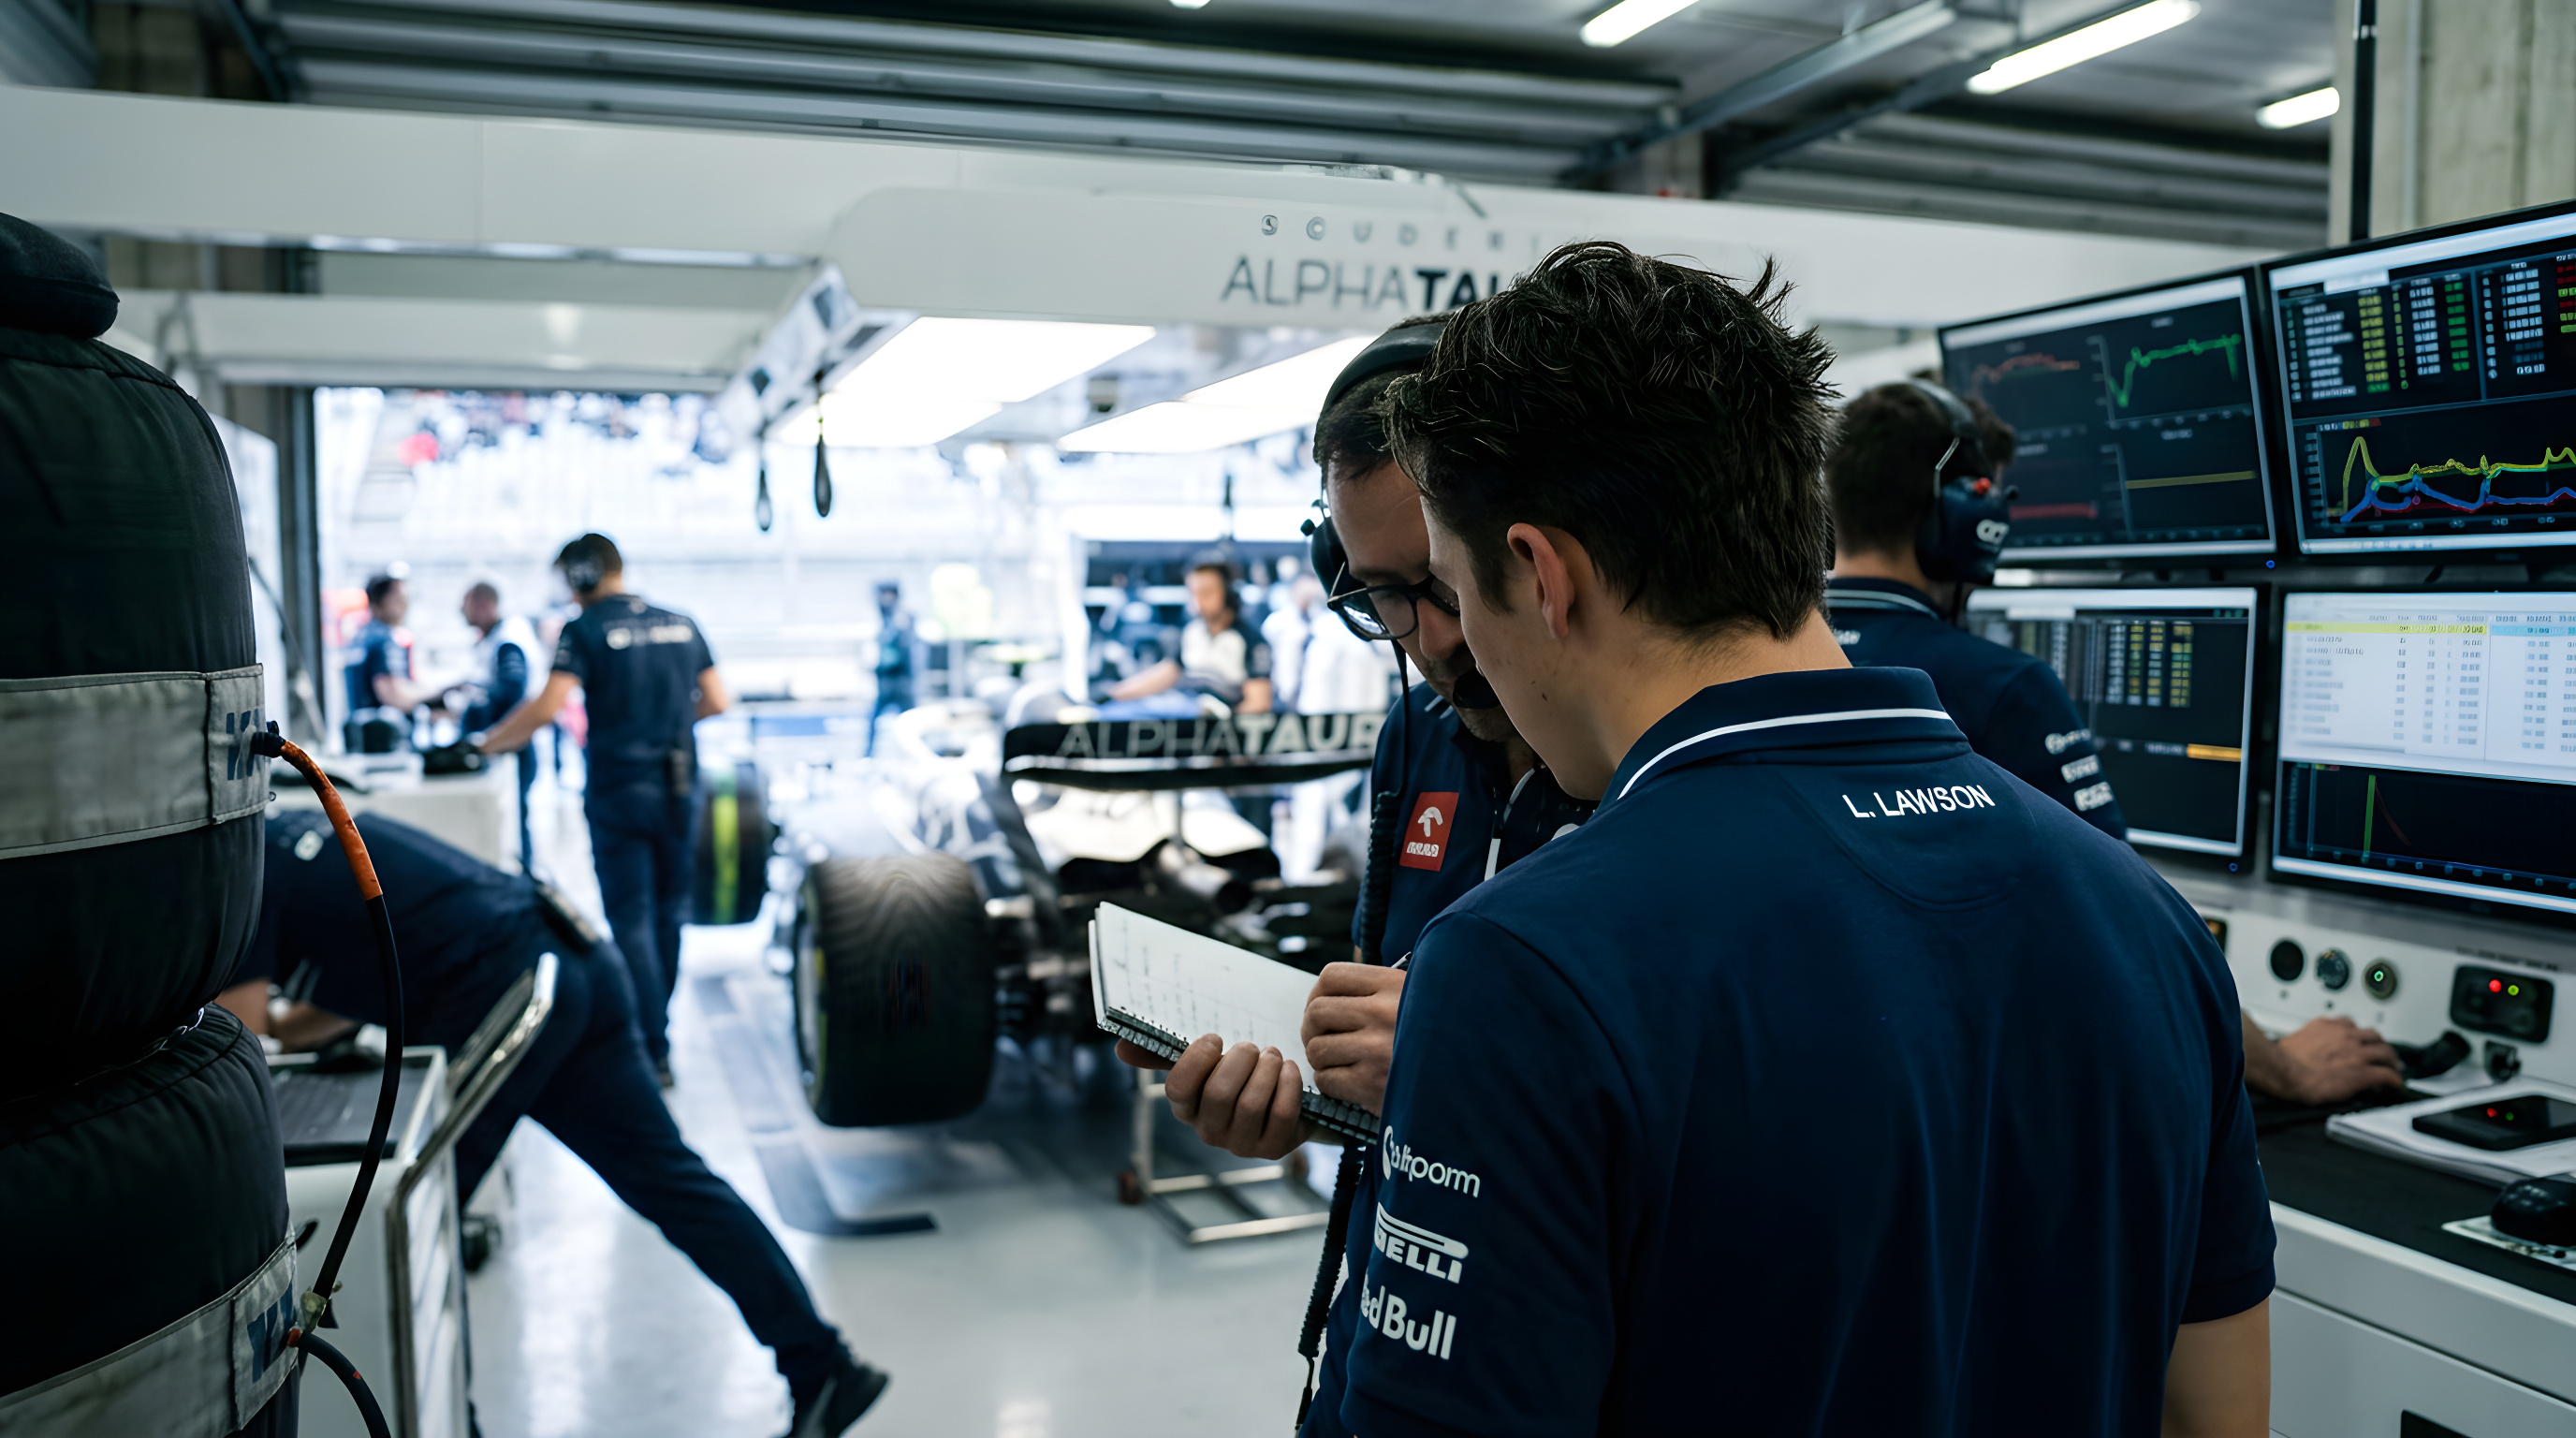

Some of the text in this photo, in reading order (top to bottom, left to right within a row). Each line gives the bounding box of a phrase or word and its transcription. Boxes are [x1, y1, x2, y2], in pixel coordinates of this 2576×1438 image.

[1222, 257, 1500, 311] ALPHATA
[1841, 785, 1996, 818] L. LAWSON
[1382, 1293, 1457, 1360] Bull
